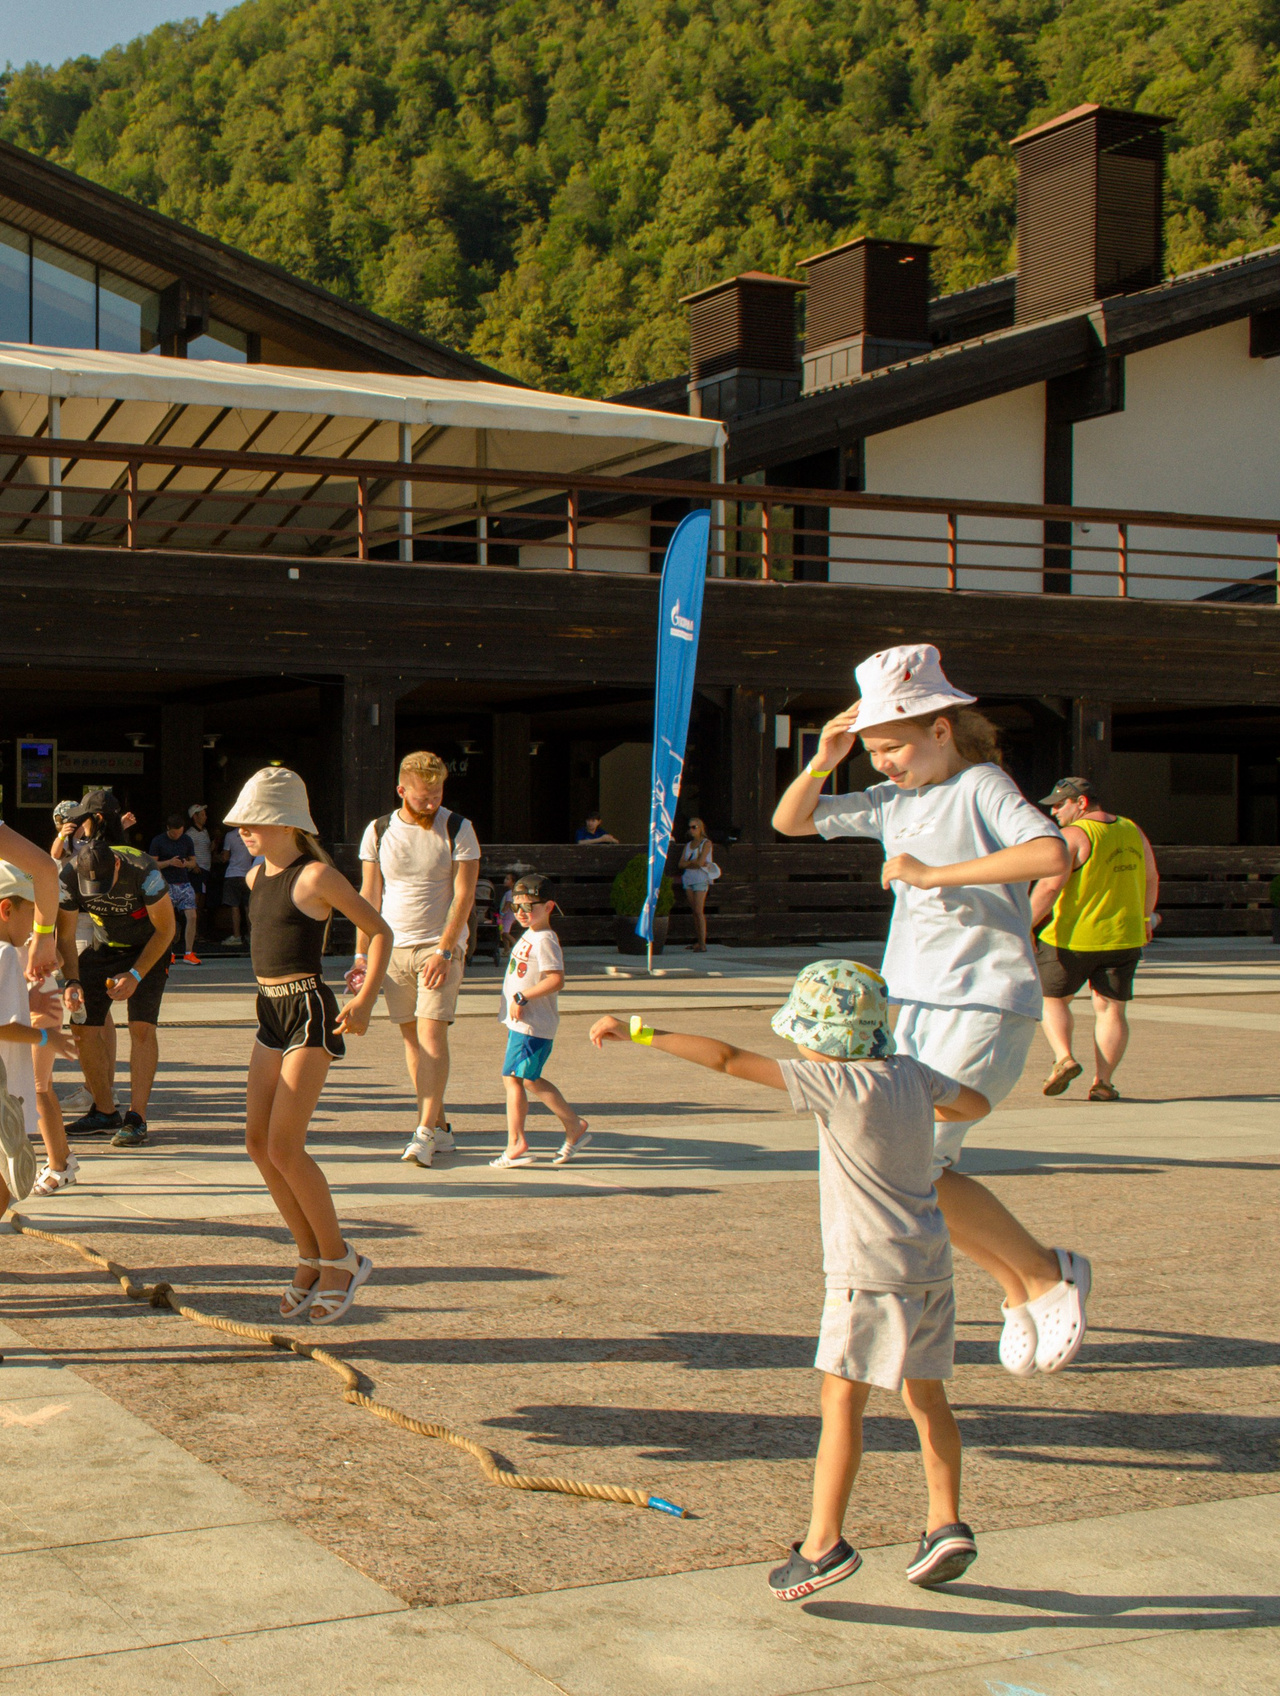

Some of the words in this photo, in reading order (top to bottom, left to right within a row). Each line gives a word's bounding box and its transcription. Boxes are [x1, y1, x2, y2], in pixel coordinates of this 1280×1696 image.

[87, 903, 108, 912] TRAIL
[290, 978, 317, 995] PARIS
[776, 1581, 815, 1600] crocs
